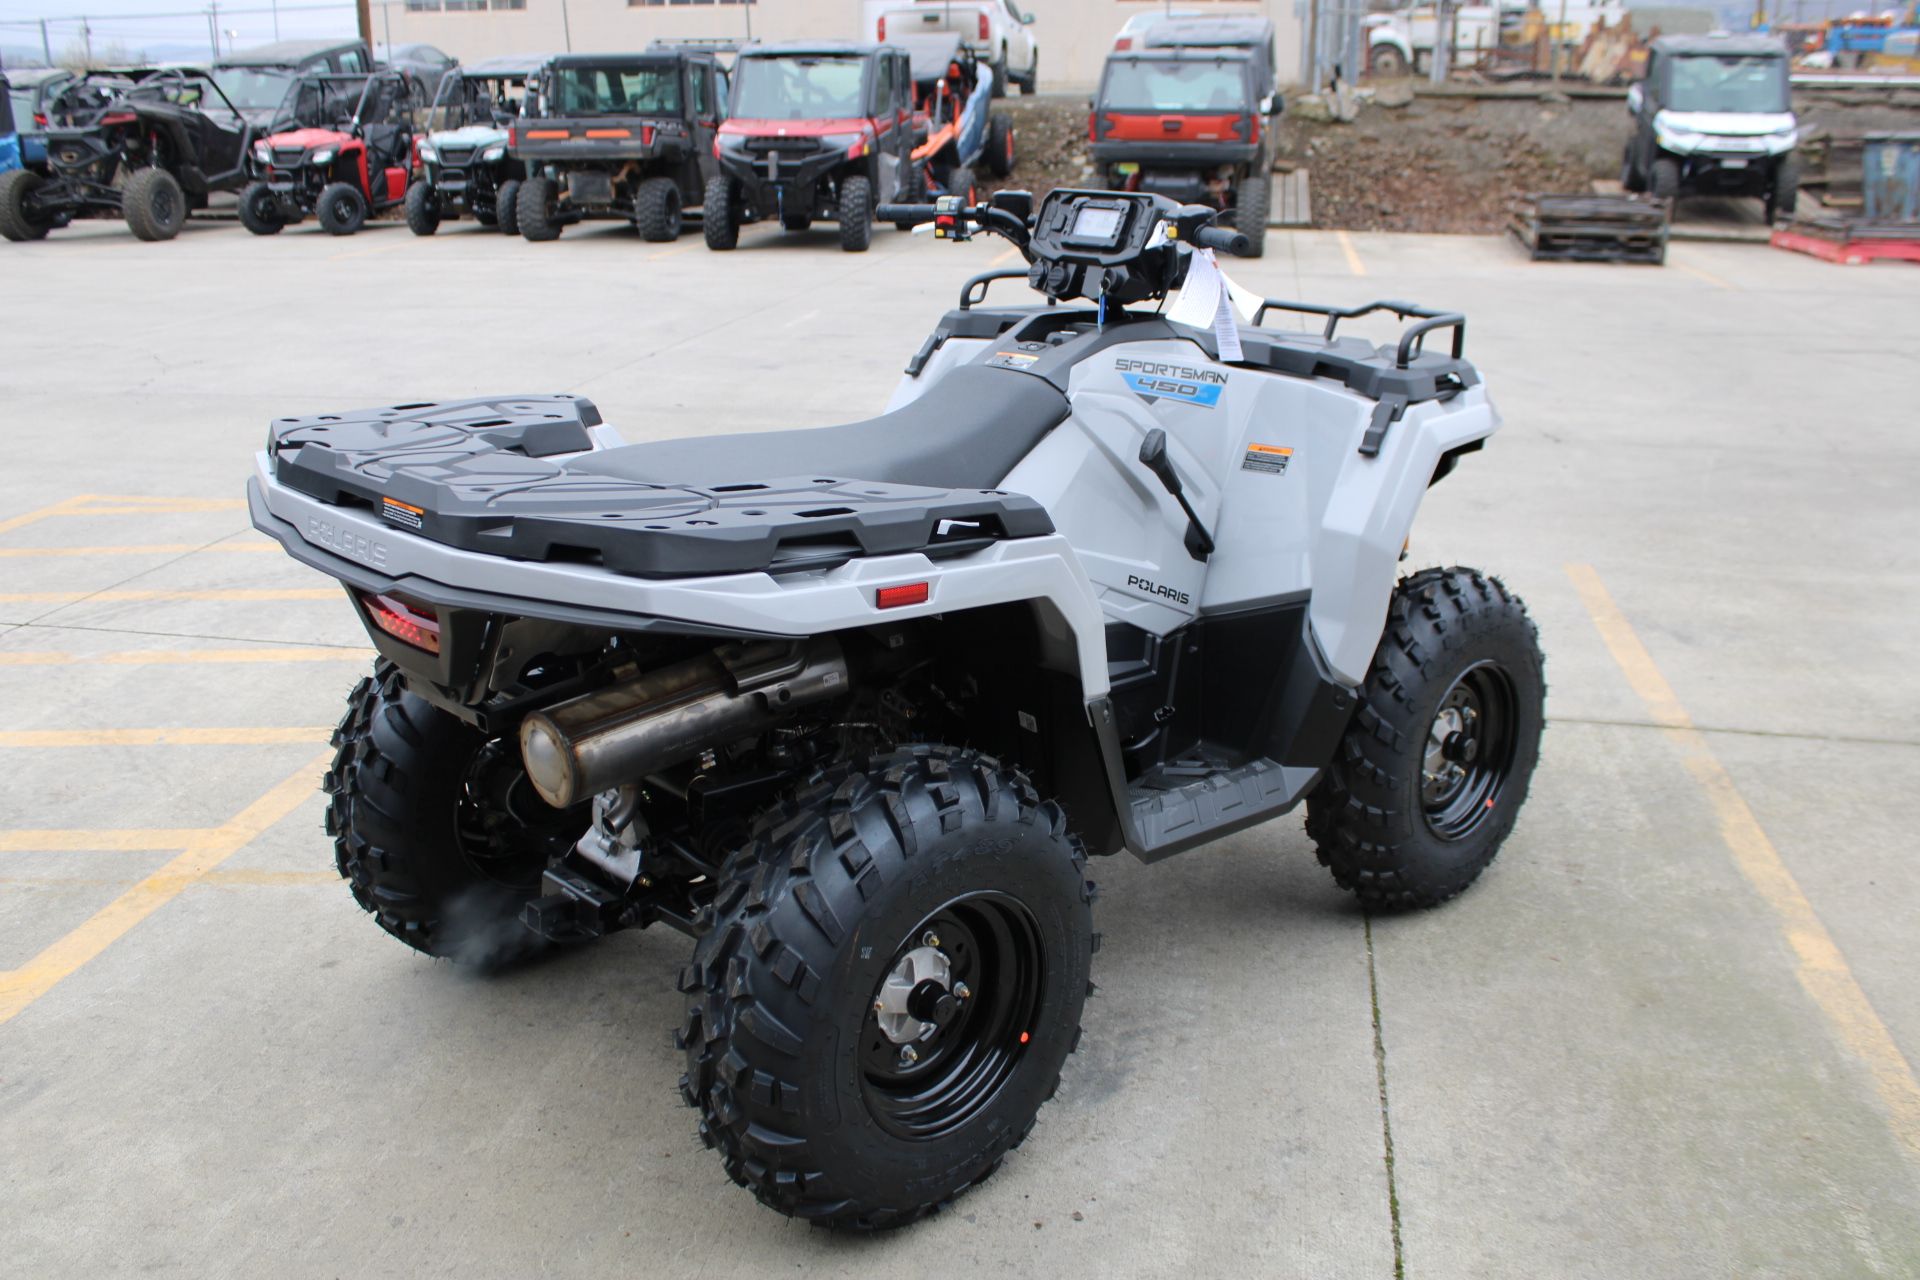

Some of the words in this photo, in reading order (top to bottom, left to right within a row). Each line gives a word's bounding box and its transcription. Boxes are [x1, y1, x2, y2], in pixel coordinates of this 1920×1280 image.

[1115, 358, 1228, 384] SPORTSMAN
[1138, 378, 1198, 395] 450
[308, 516, 388, 567] POLARIS
[1127, 574, 1189, 604] POLARIS
